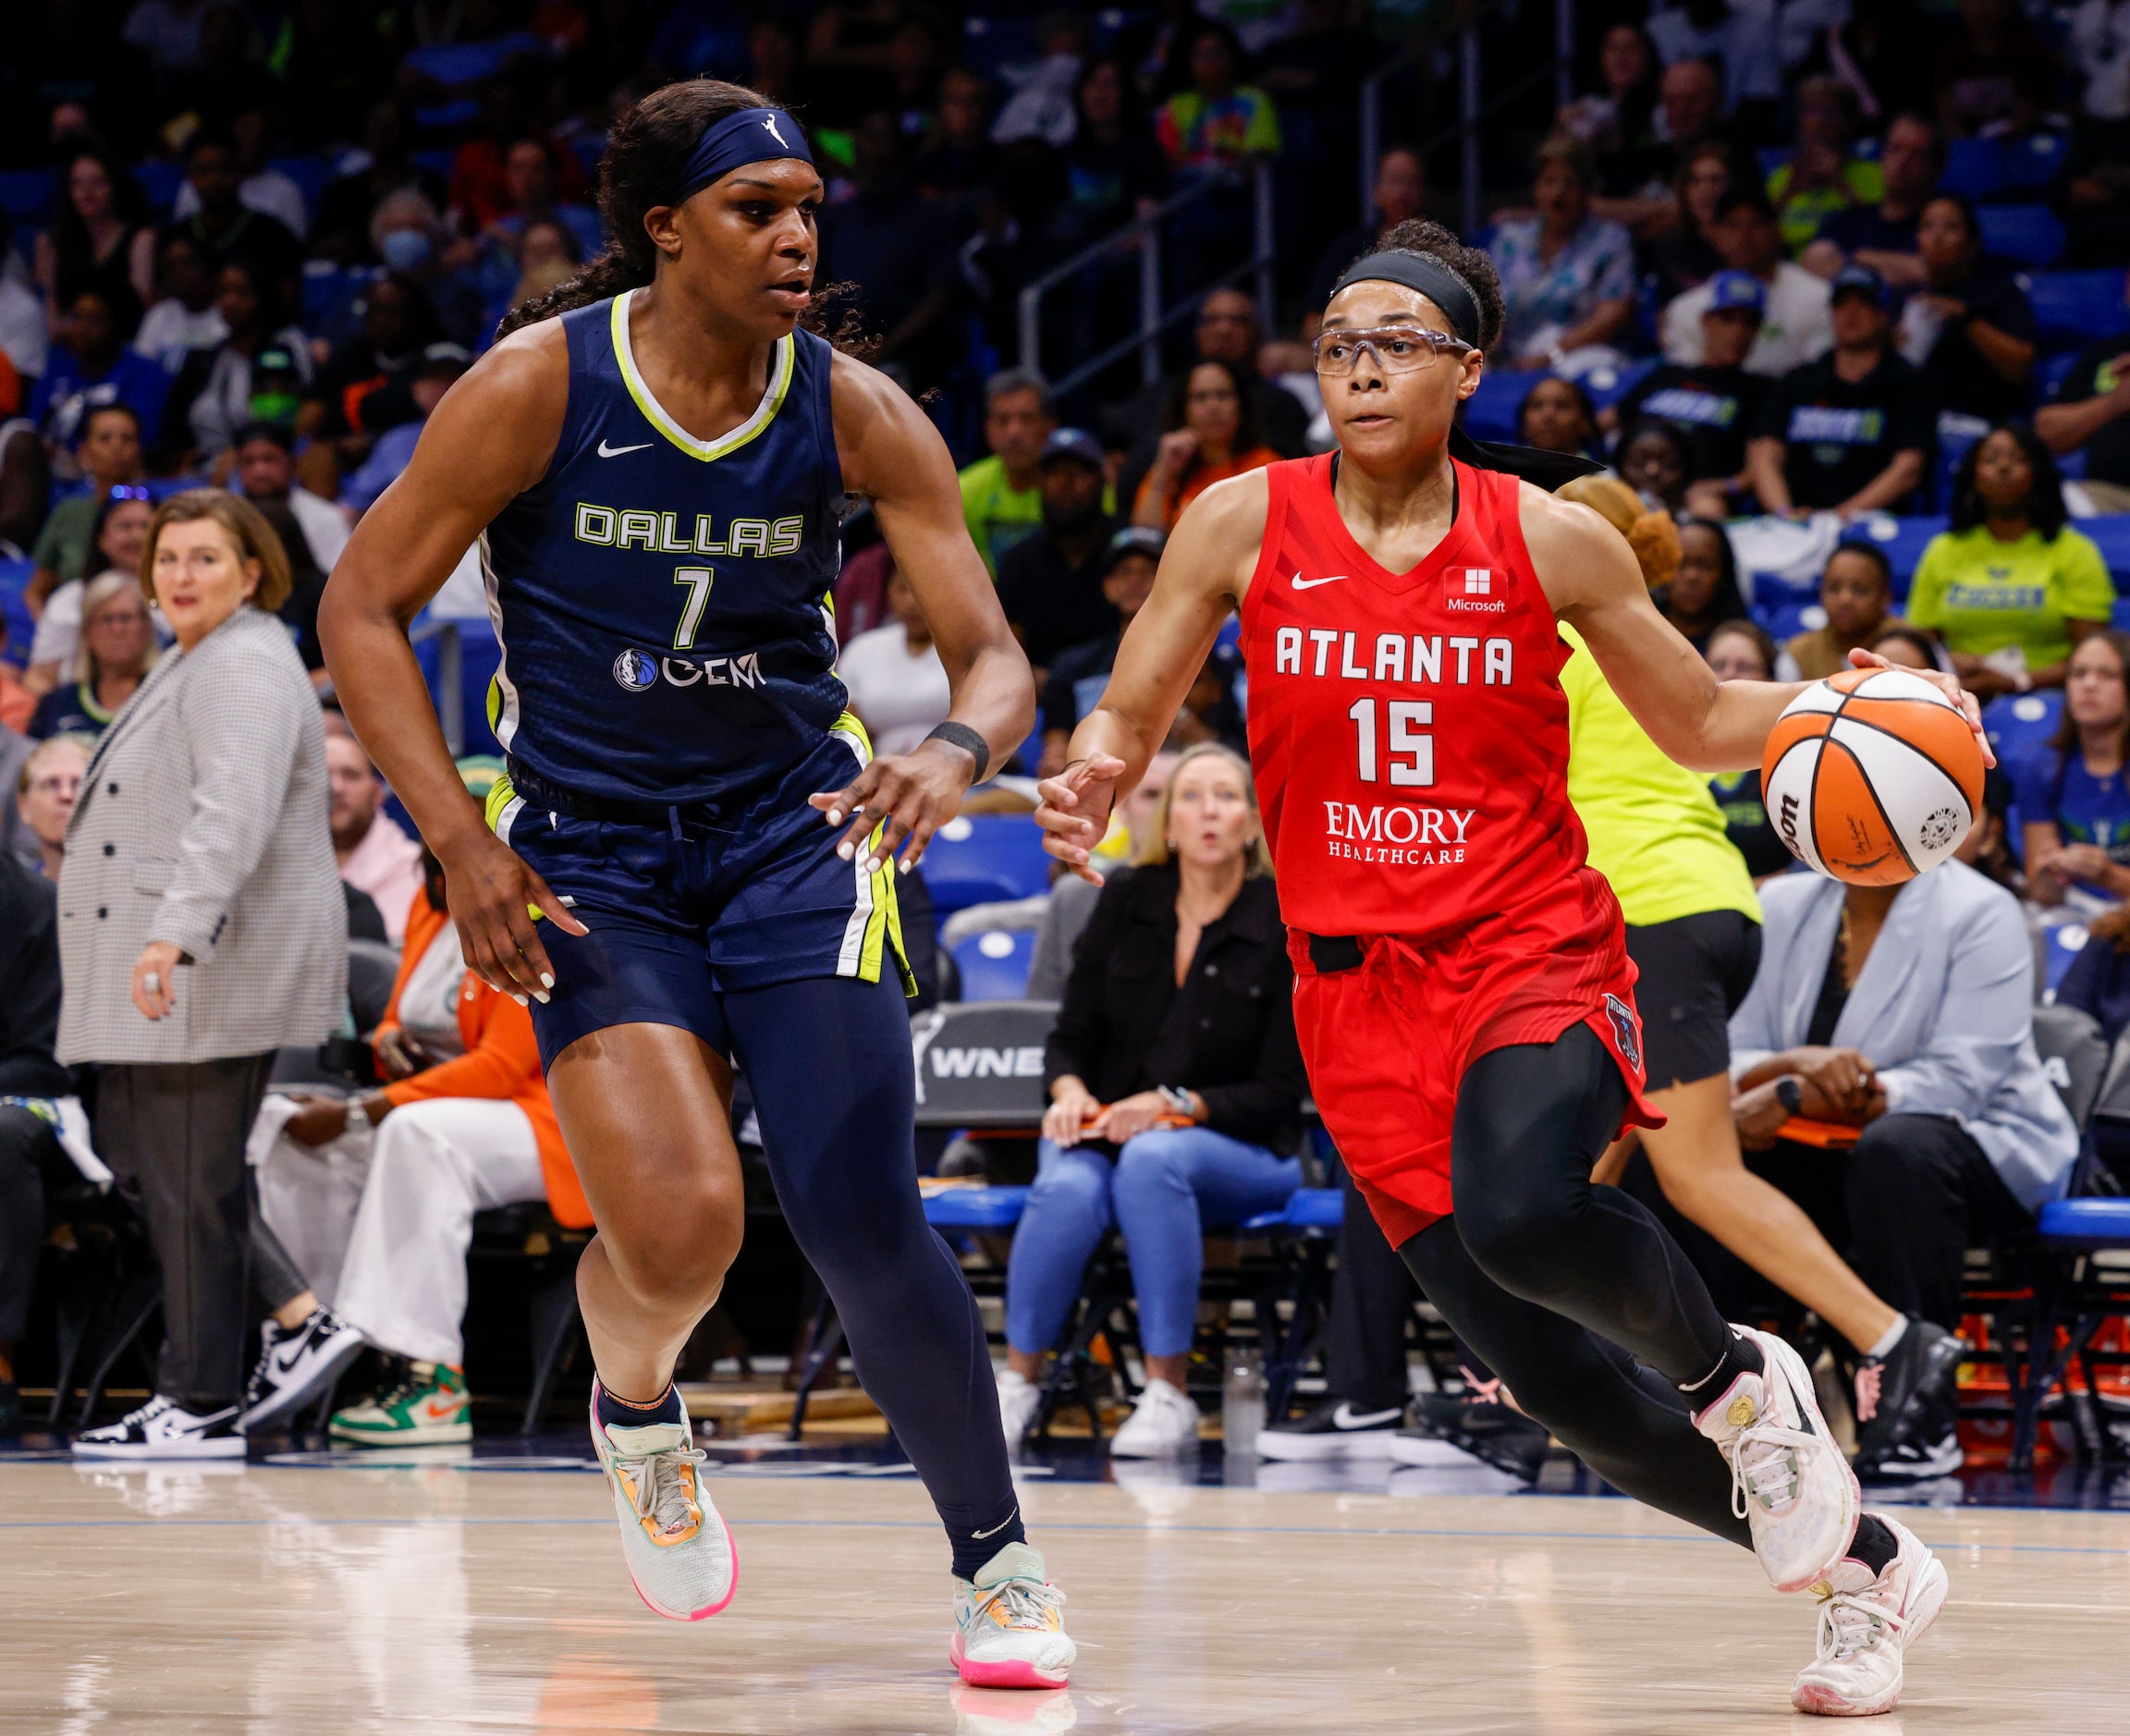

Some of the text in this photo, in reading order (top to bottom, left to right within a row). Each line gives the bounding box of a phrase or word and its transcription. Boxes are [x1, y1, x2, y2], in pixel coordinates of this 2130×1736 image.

[575, 502, 803, 557] DALLAS
[673, 567, 714, 650] 7
[1448, 599, 1506, 613] Microsoft
[1276, 625, 1513, 686] ATLANTA
[1349, 697, 1435, 787] 15
[1323, 801, 1476, 844] EMORY
[1328, 841, 1464, 865] HEALTHCARE
